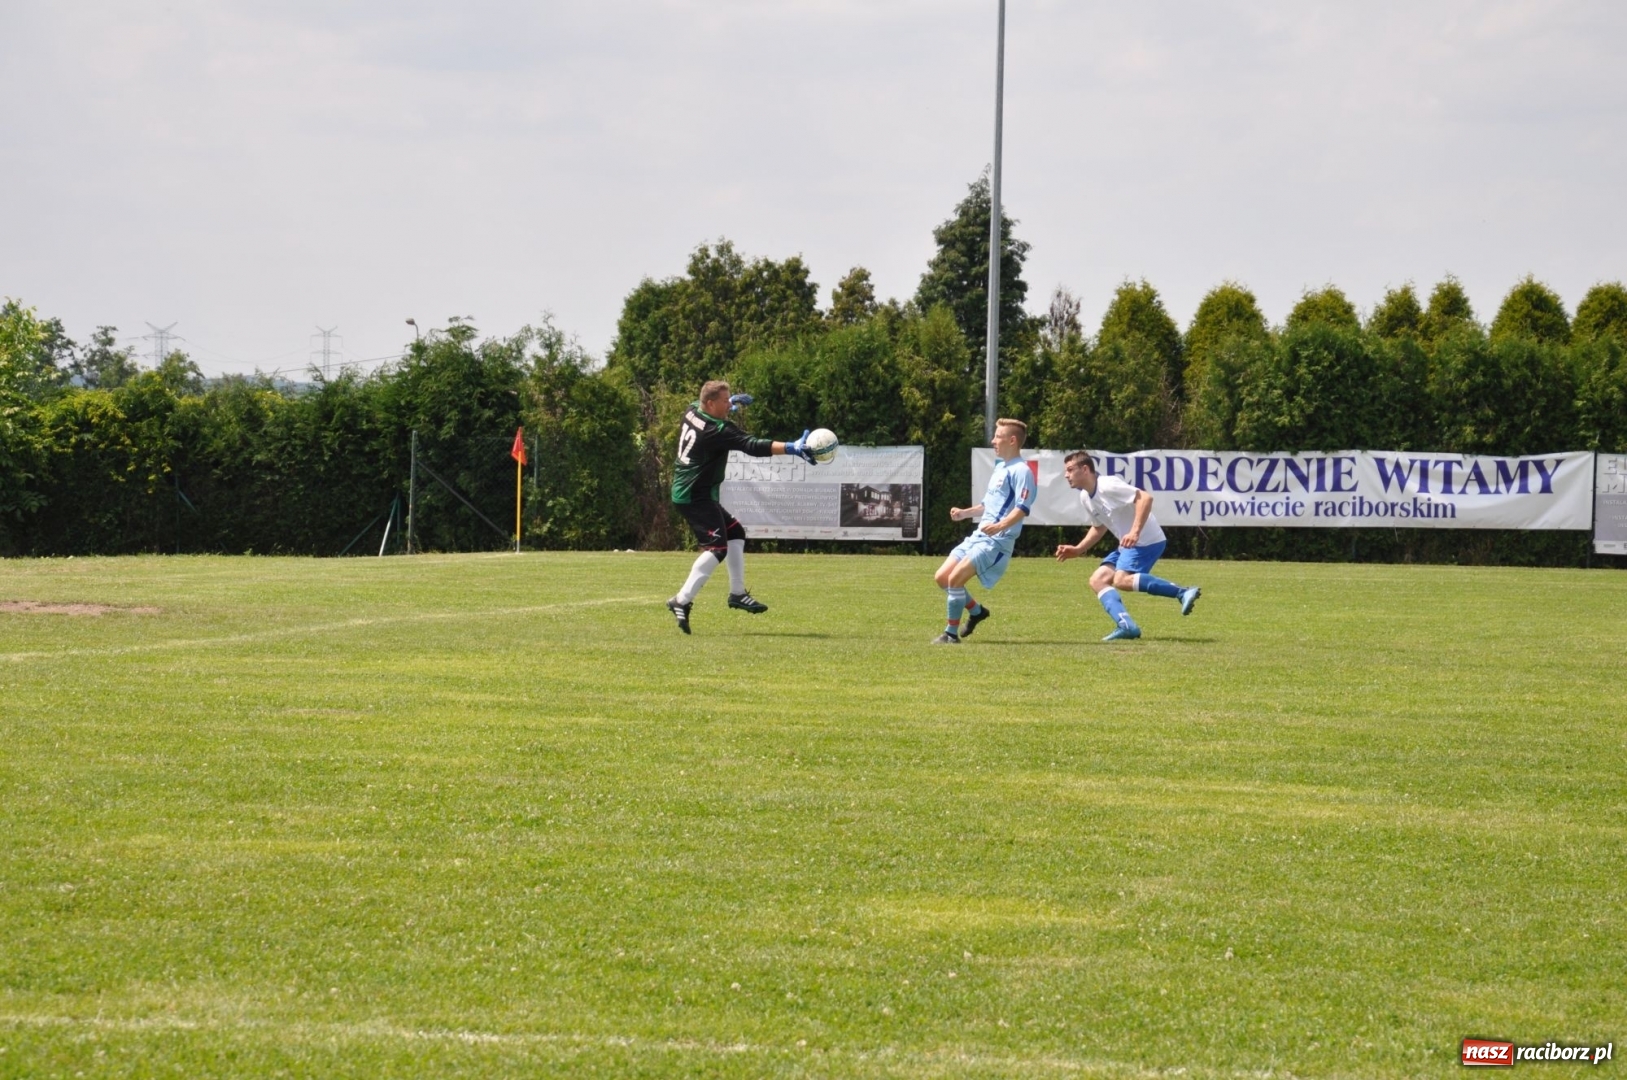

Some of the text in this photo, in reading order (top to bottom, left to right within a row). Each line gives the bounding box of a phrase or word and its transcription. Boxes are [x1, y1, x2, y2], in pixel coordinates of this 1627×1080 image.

[678, 423, 697, 465] 12
[1375, 458, 1565, 494] WITAMY
[1175, 495, 1456, 521] w powiecie raciborskim
